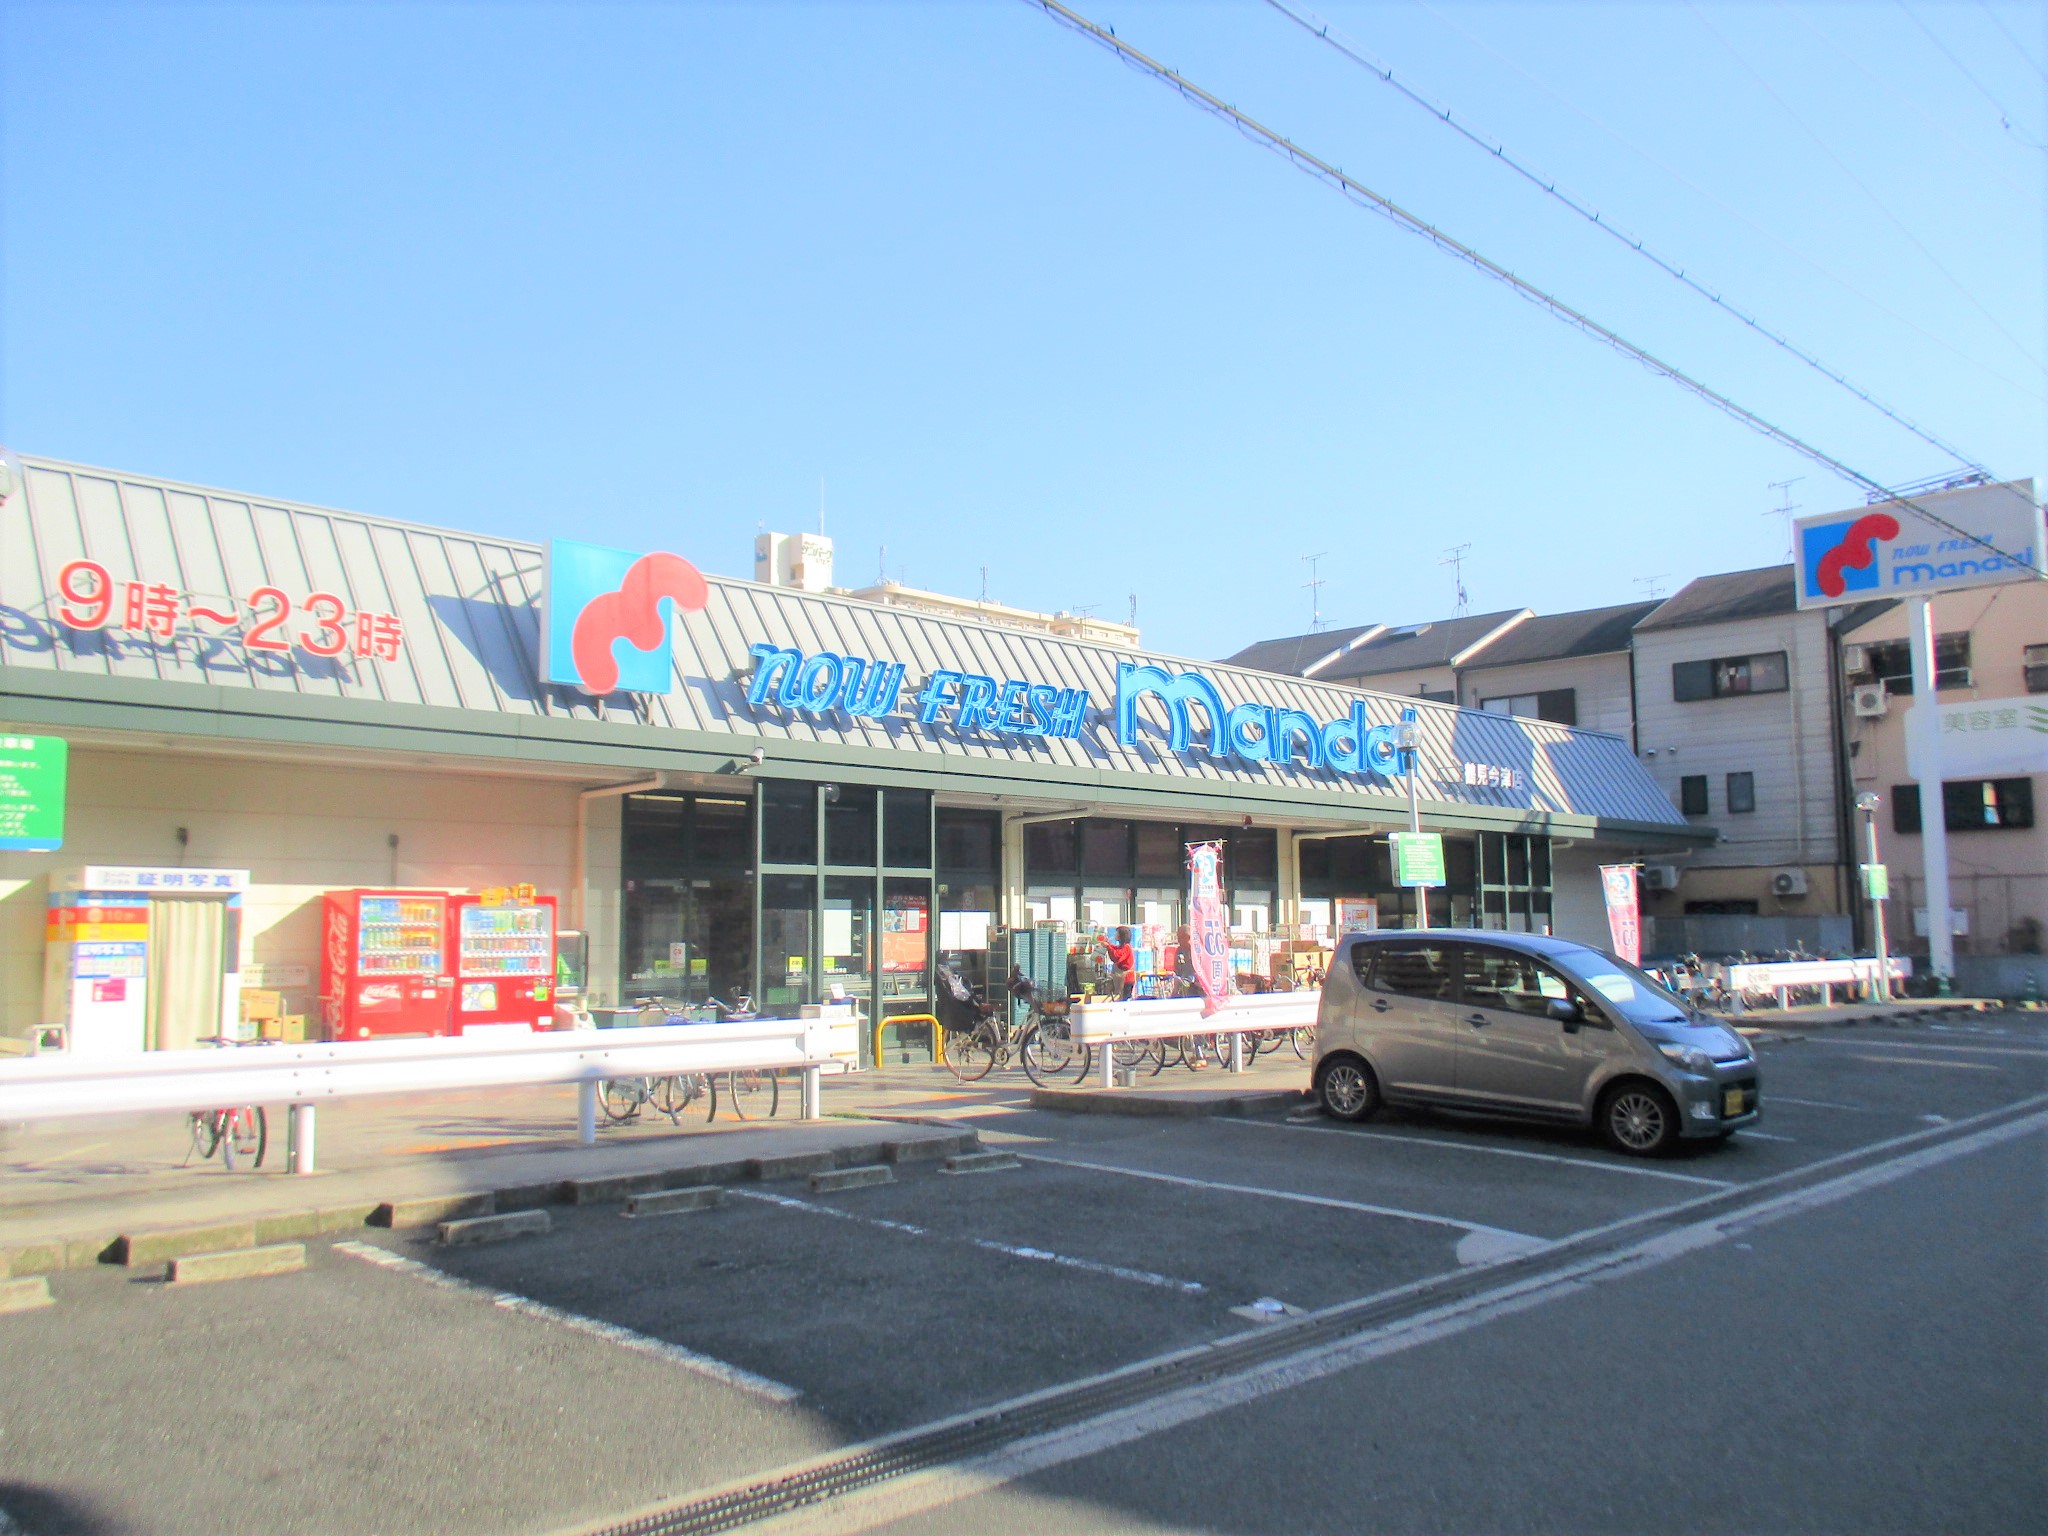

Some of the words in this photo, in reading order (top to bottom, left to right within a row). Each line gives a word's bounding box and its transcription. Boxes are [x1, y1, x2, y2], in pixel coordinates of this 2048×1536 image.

[917, 669, 1090, 739] FRESH
[137, 872, 232, 887] 証明写真
